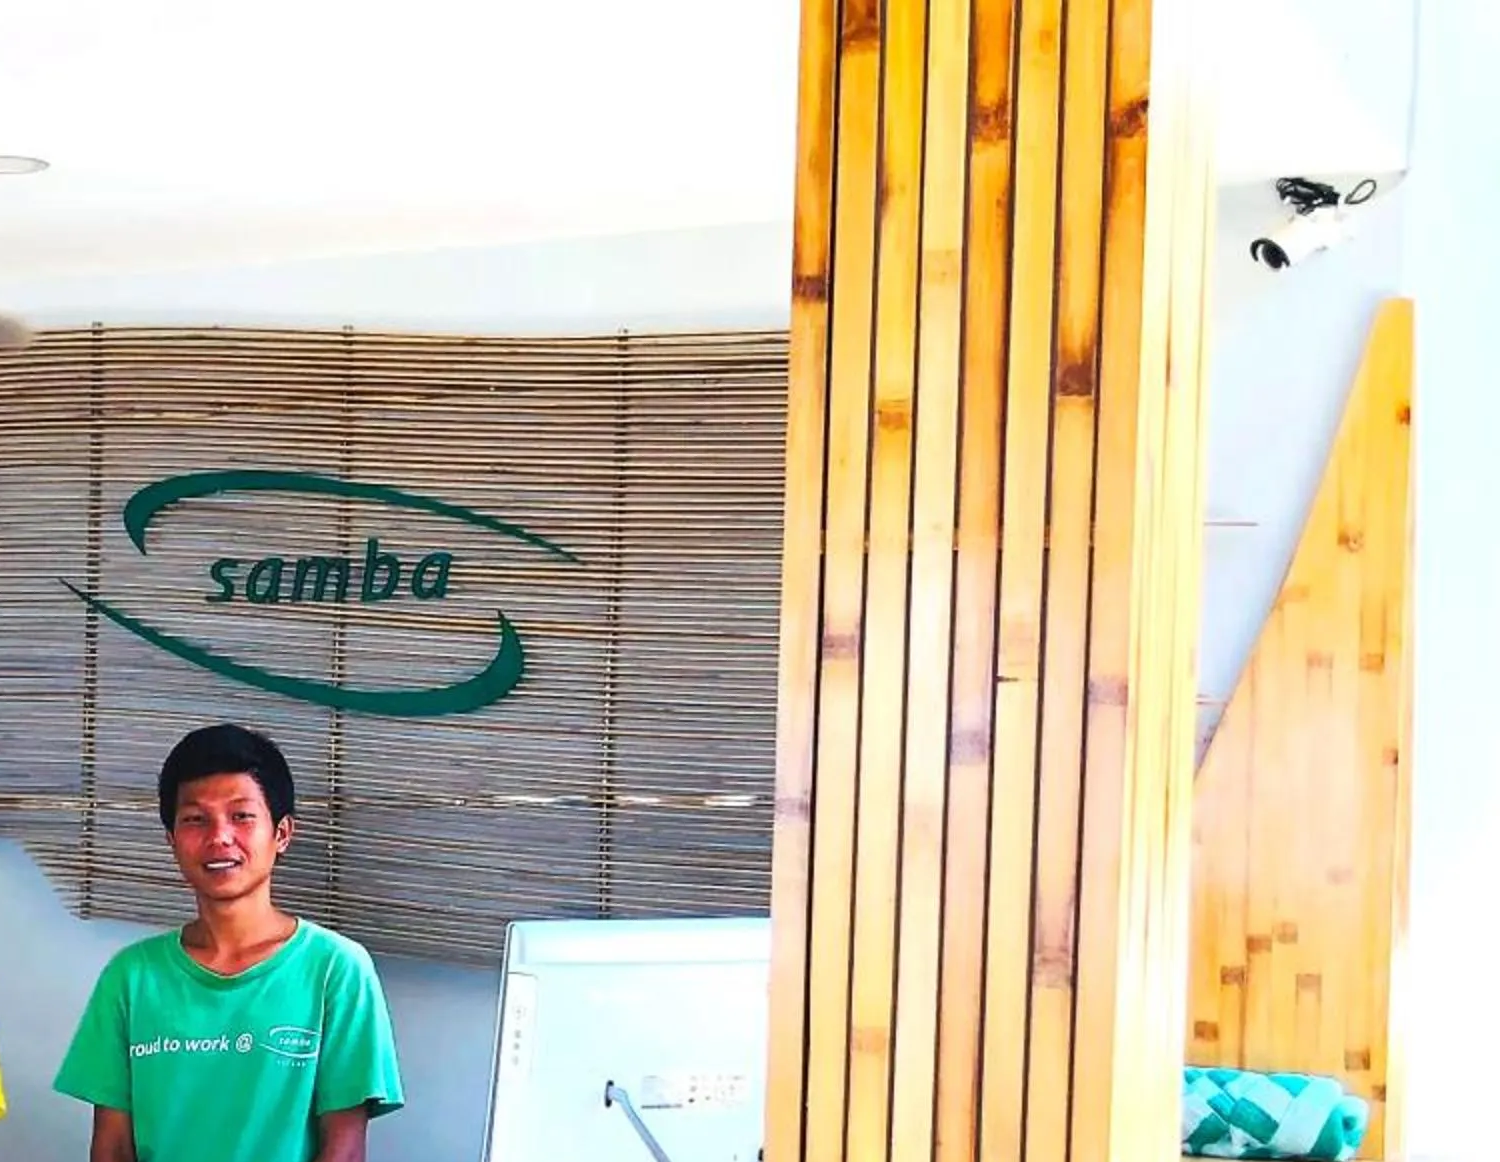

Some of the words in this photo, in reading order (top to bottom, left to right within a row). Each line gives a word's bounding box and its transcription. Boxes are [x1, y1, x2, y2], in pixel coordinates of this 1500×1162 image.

[206, 536, 453, 603] samba
[129, 1036, 161, 1057] roud
[163, 1037, 180, 1052] to
[185, 1035, 230, 1052] work
[235, 1033, 253, 1053] @
